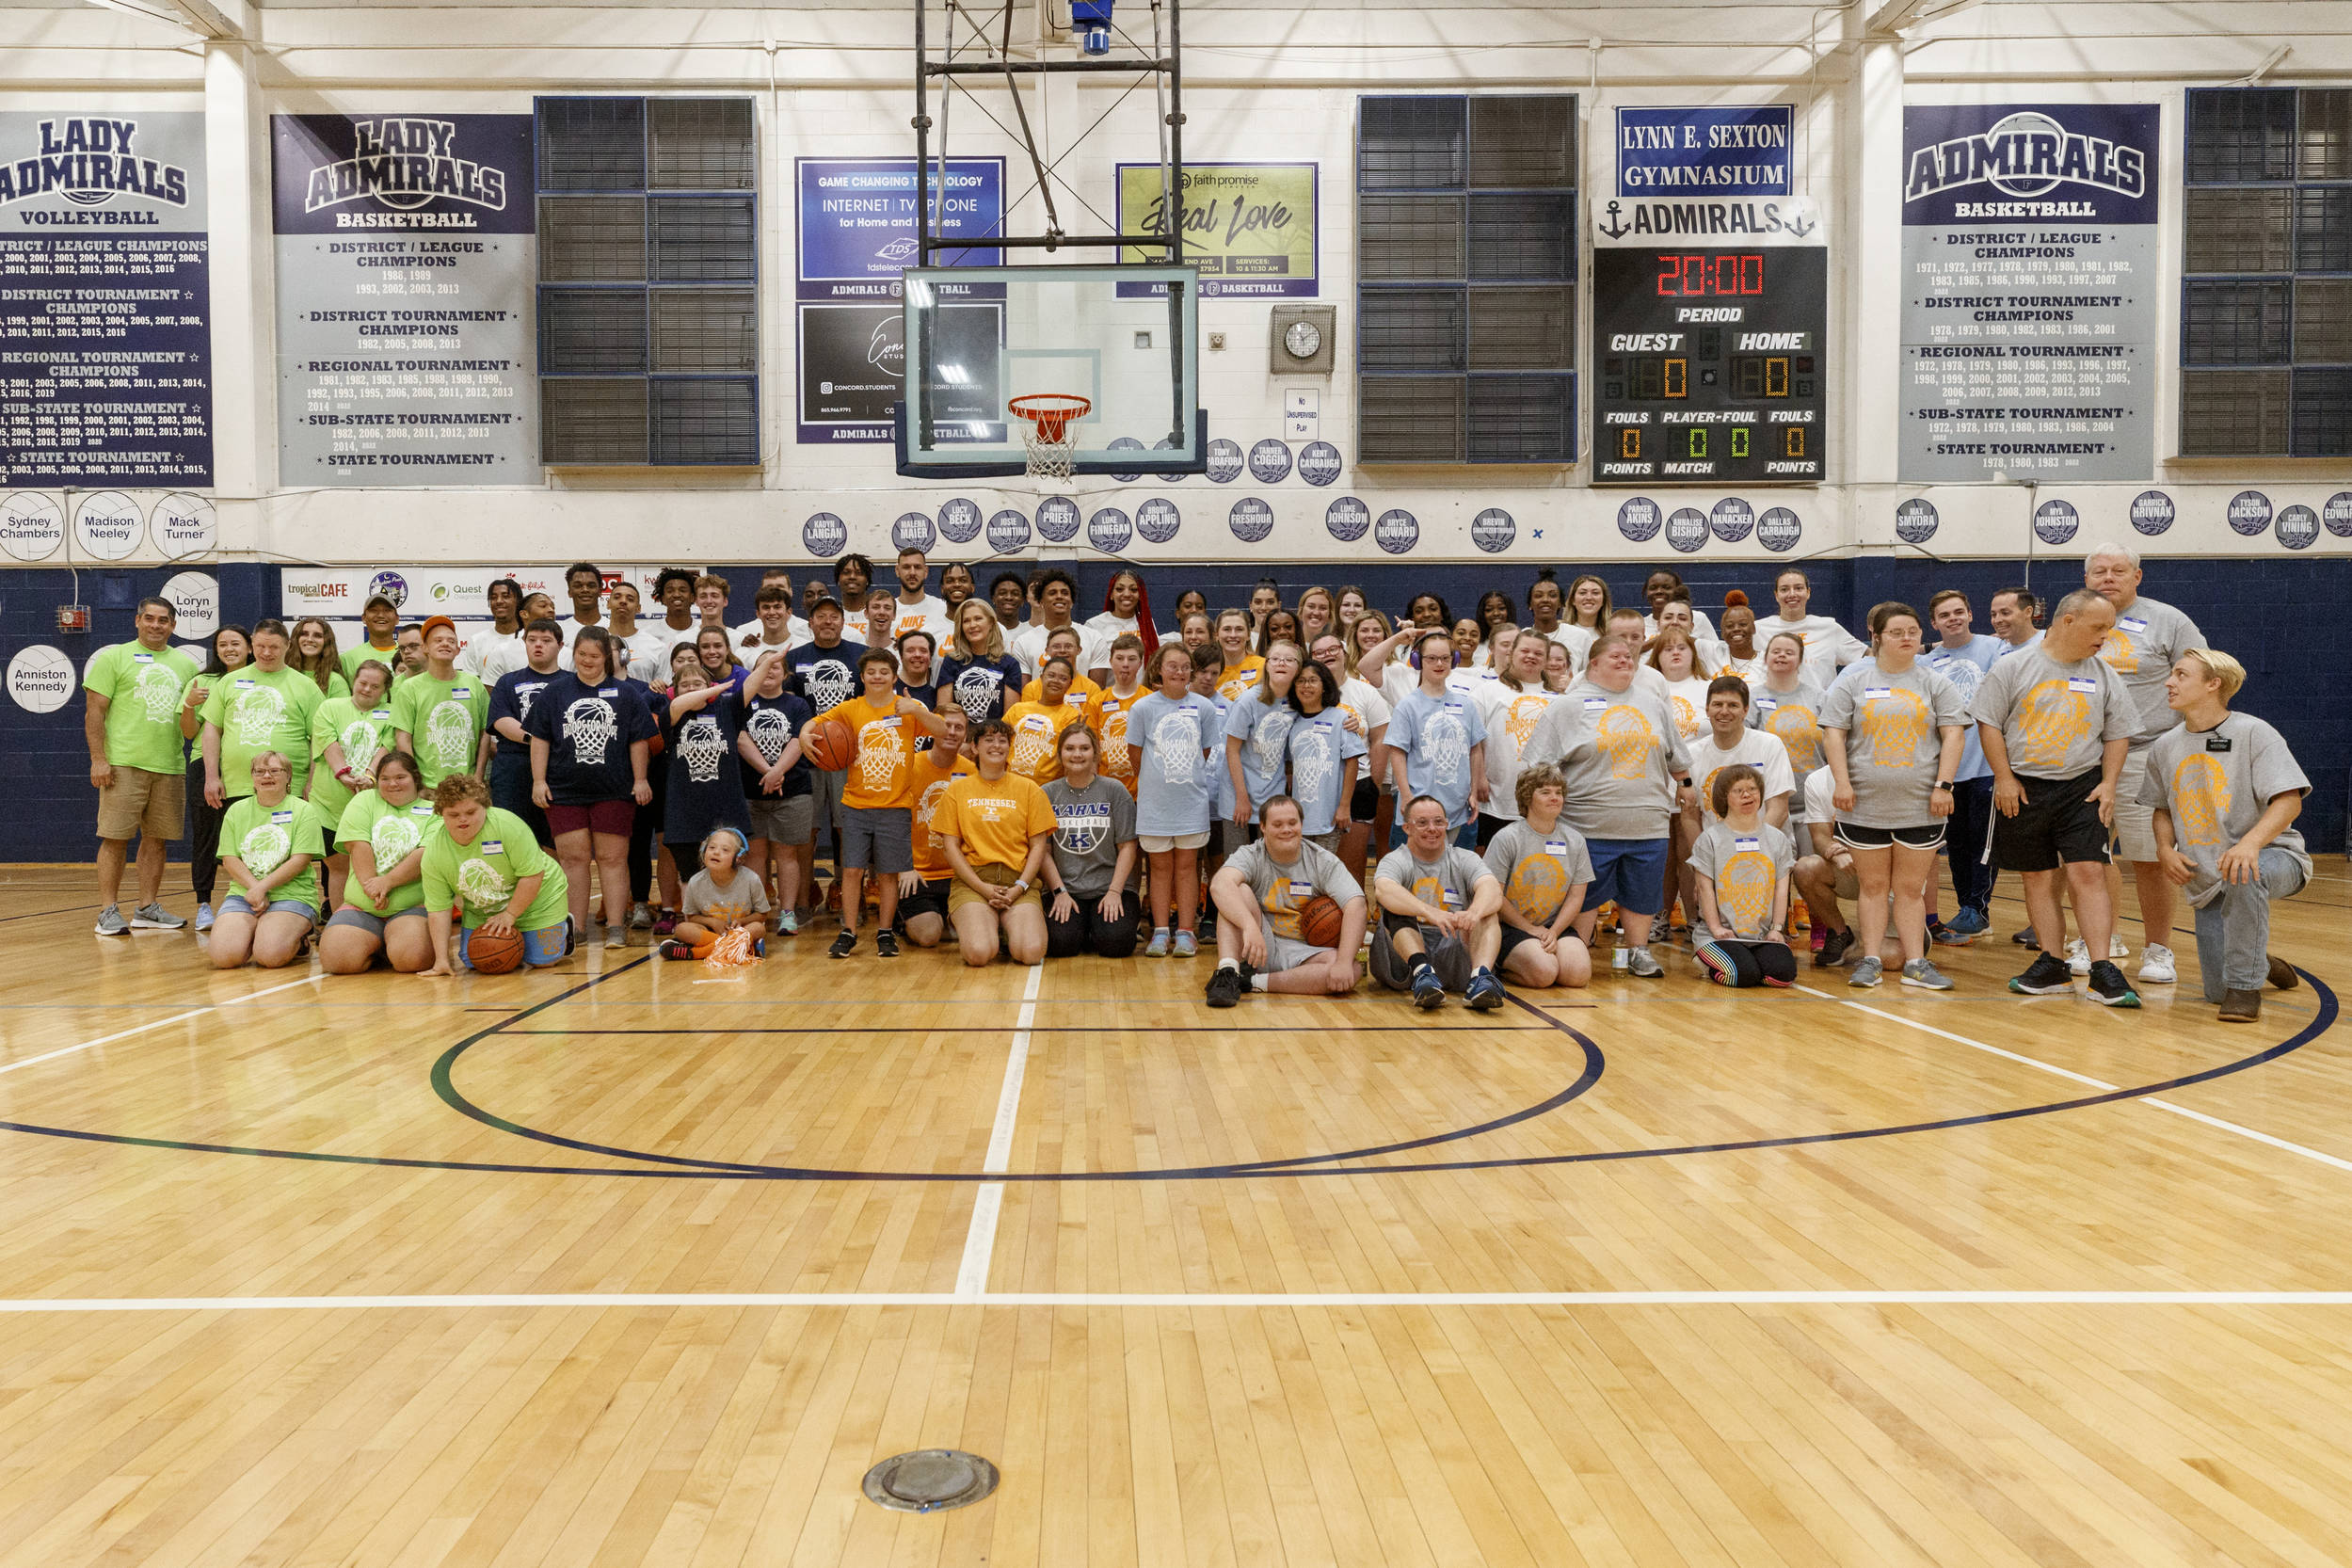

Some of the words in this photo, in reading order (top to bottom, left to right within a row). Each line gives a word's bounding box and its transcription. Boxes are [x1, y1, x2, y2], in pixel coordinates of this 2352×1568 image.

[39, 118, 136, 155] LADY
[355, 119, 455, 157] LADY
[1624, 126, 1675, 149] LYNN
[1684, 125, 1701, 149] E.
[1709, 124, 1785, 148] SEXTON
[1906, 132, 2144, 202] ADMIRALS
[0, 152, 187, 207] ADMIRALS
[1624, 165, 1784, 186] GYMNASIUM
[306, 155, 505, 214] ADMIRALS
[819, 178, 848, 186] GAME
[852, 177, 908, 186] CHANGING
[912, 177, 983, 186] TCHOLOGY
[1194, 174, 1217, 185] faith
[1218, 175, 1258, 190] promise
[824, 200, 888, 212] INTERNET
[900, 200, 915, 211] TV
[1955, 202, 2096, 216] BASKETBALL
[20, 212, 159, 224] VOLLEYBALL
[336, 214, 477, 227] BASKETBALL
[840, 218, 854, 227] for
[857, 218, 888, 227] Home
[891, 218, 912, 227] and
[1225, 195, 1292, 247] Love
[1635, 203, 1782, 233] ADMIRALS
[1947, 234, 2025, 244] DISTRICT
[2040, 233, 2101, 243] LEAGUE
[56, 241, 112, 251] LEAGUE
[117, 241, 207, 251] CHAMPIONS
[329, 243, 405, 252] DISTRICT
[420, 243, 483, 252] LEAGUE
[889, 246, 911, 254] TDS
[1975, 248, 2074, 258] CHAMPIONS
[357, 257, 456, 266] CHAMPIONS
[1658, 256, 1763, 295] 20:00
[2, 290, 72, 300] DISTRICT
[75, 290, 180, 300] TOURNAMENT
[832, 286, 887, 295] ADMIRALS
[1925, 297, 2003, 308] DISTRICT
[2008, 296, 2121, 307] TOURNAMENT
[46, 304, 136, 313] CHAMPIONS
[311, 312, 387, 322] DISTRICT
[392, 311, 506, 321] TOURNAMENT
[1678, 309, 1741, 322] PERIOD
[1974, 311, 2073, 321] CHAMPIONS
[360, 325, 458, 335] CHAMPIONS
[1611, 334, 1683, 351] GUEST
[1739, 333, 1804, 350] HOME
[2, 353, 78, 362] REGIONAL
[82, 352, 185, 362] TOURNAMENT
[1920, 347, 2005, 357] REGIONAL
[2010, 346, 2123, 357] TOURNAMENT
[49, 366, 139, 376] CHAMPIONS
[309, 361, 392, 371] REGIONAL
[396, 360, 509, 371] TOURNAMENT
[1665, 359, 1687, 397] 0
[1767, 358, 1788, 396] 0
[3, 404, 80, 413] SUB-STATE
[84, 403, 186, 413] TOURNAMENT
[1919, 408, 2005, 419] SUB-STATE
[2009, 408, 2123, 419] TOURNAMENT
[309, 415, 394, 424] SUB-STATE
[398, 414, 511, 424] TOURNAMENT
[1607, 412, 1649, 424] FOULS
[1663, 412, 1756, 423] PLAYER-FOUL
[1770, 411, 1812, 422] FOULS
[833, 430, 888, 439] ADMIRALS
[1624, 429, 1640, 457] 0
[1690, 428, 1706, 457] 0
[1732, 428, 1749, 456] 0
[1787, 427, 1804, 456] 0
[1937, 444, 1986, 454] STATE
[1991, 443, 2104, 454] TOURNAMENT
[21, 453, 64, 462] STATE
[68, 452, 171, 462] TOURNAMENT
[328, 456, 376, 465] STATE
[380, 455, 494, 465] TOURNAMENT
[1255, 456, 1286, 465] COGGIN
[1301, 459, 1339, 468] CARBAUGH
[1604, 463, 1652, 473] POINTS
[1665, 463, 1712, 473] MATCH
[1768, 462, 1816, 472] POINTS
[1044, 512, 1073, 523] PRIEST
[2133, 506, 2171, 518] HRIVNAK
[2230, 506, 2269, 518] JACKSON
[8, 517, 50, 527] Sydney
[86, 517, 134, 526] Madison
[169, 518, 200, 527] Mack
[950, 515, 971, 524] BECK
[1140, 514, 1176, 525] APPLING
[1328, 512, 1367, 524] JOHNSON
[1387, 519, 1406, 527] BRYCE
[1626, 514, 1654, 525] AKINS
[1713, 514, 1752, 524] VANACKER
[2036, 516, 2077, 527] JOHNSTON
[1091, 524, 1129, 535] FINNEGAN
[1379, 527, 1415, 537] HOWARD
[1672, 526, 1704, 537] BISHOP
[1759, 526, 1800, 536] CARBAUGH
[2282, 522, 2312, 532] VINING
[0, 528, 60, 538] Chambers
[90, 529, 130, 539] Neeley
[166, 530, 204, 539] Turner
[808, 529, 841, 538] LANGAN
[901, 529, 927, 539] MAIER
[288, 584, 320, 595] tropical
[321, 584, 347, 597] CAFE
[454, 585, 481, 594] Quest
[177, 596, 209, 607] Loryn
[902, 616, 926, 628] NIKE
[15, 670, 66, 679] Anniston
[15, 682, 67, 693] Kennedy
[968, 799, 1016, 808] TENNESSEE
[1069, 834, 1089, 847] K
